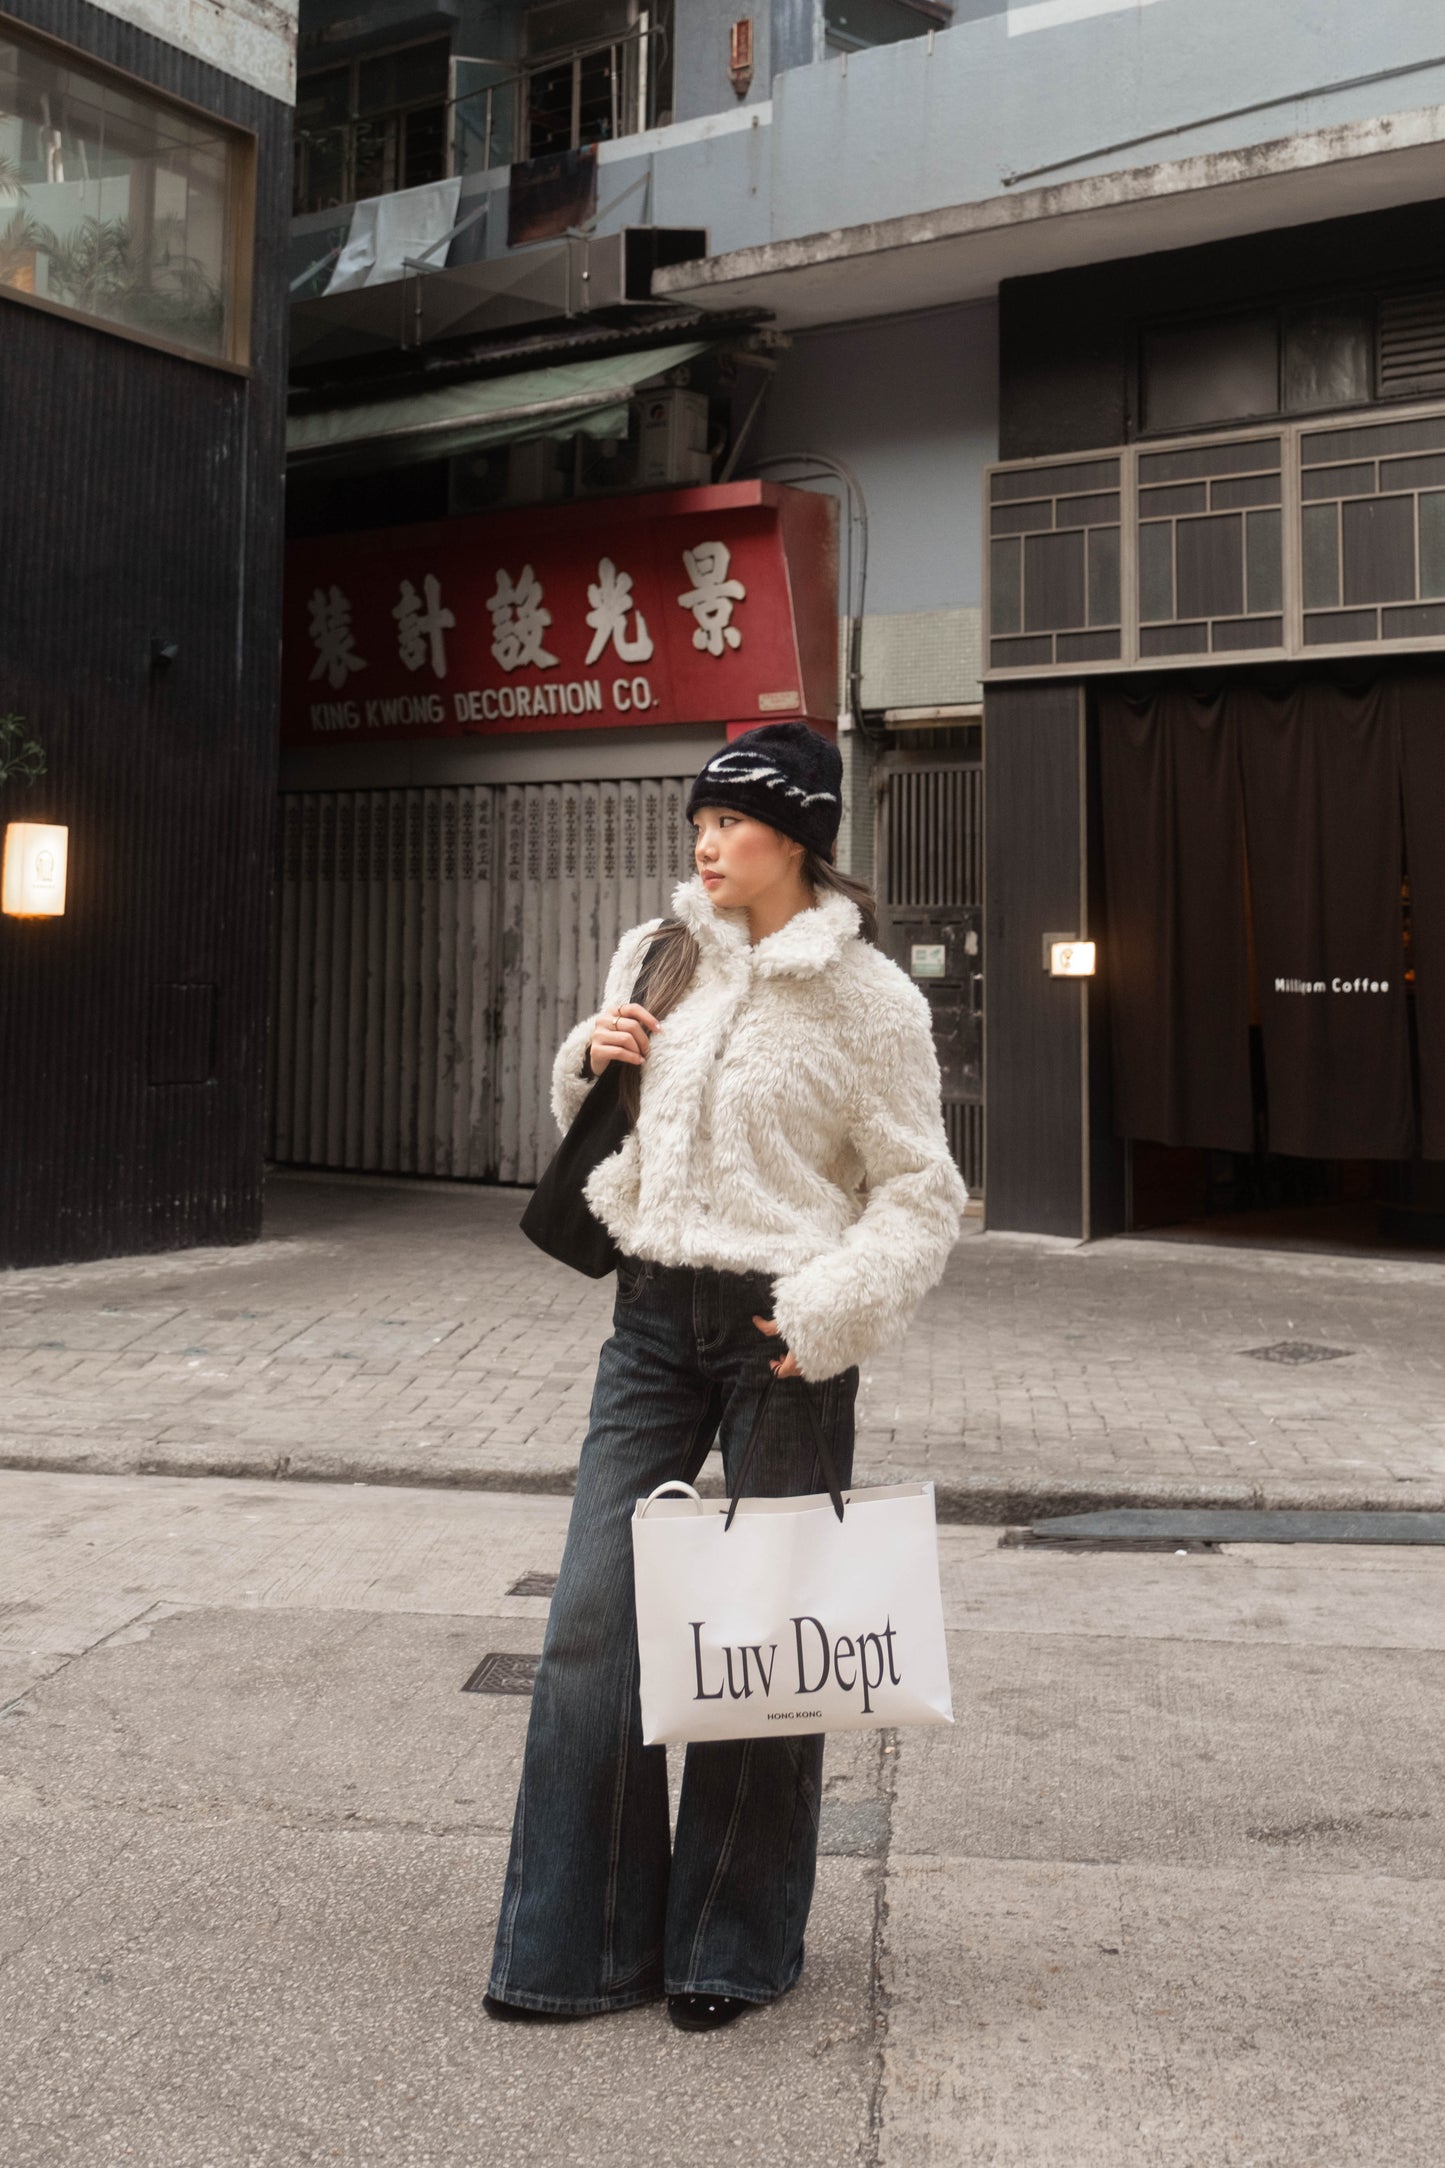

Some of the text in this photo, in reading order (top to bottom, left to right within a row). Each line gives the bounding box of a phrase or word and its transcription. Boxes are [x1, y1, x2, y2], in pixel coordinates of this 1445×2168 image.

[310, 676, 660, 731] KING KWONG DECORATION CO.
[1332, 977, 1389, 993] Coffee
[688, 1613, 902, 1714] Luv Dept
[767, 1710, 822, 1720] HONG KONG
